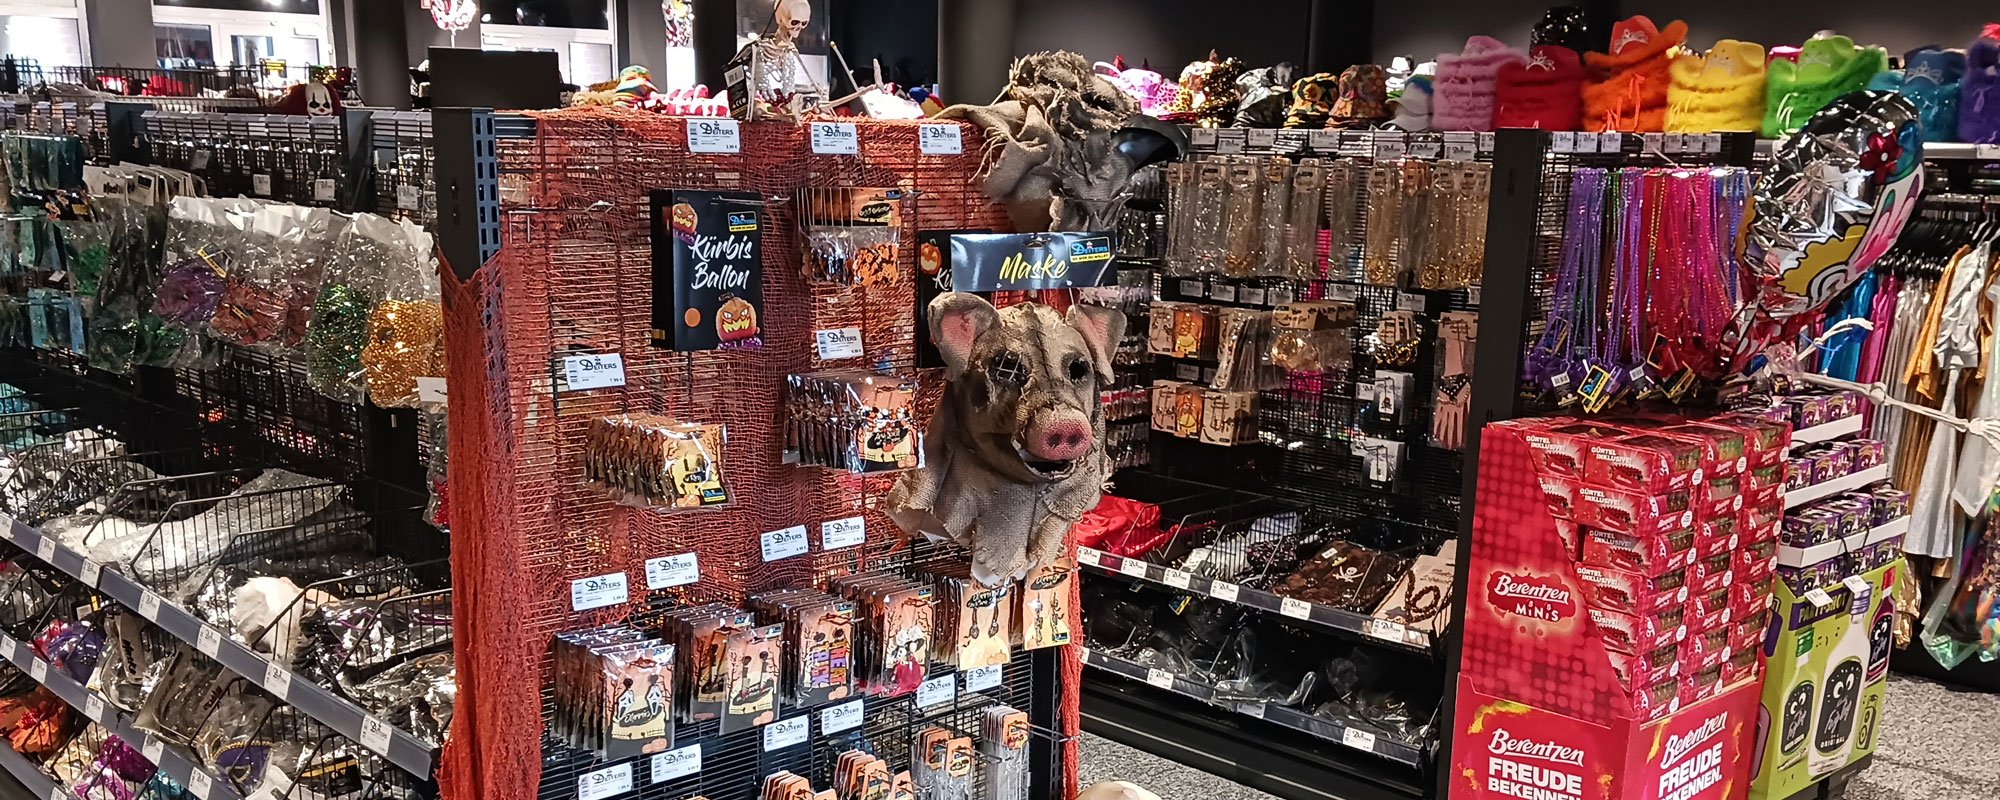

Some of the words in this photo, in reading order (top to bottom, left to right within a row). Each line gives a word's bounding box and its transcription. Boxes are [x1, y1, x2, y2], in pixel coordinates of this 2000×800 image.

[700, 122, 734, 135] DEITERS
[822, 125, 852, 138] DEITERS
[929, 126, 957, 138] DEITERS
[1071, 242, 1108, 255] DEITERS
[688, 234, 753, 282] Kürbis
[999, 251, 1070, 285] Maske
[691, 262, 750, 290] Ballon
[579, 358, 617, 371] DEITERS
[833, 522, 860, 533] DEITERS
[772, 533, 803, 544] DEITERS
[658, 560, 692, 571] DEITERS
[585, 580, 621, 592] DEITERS
[1494, 574, 1570, 604] Berentzen
[832, 708, 859, 718] DEITERS
[776, 722, 804, 733] DEITERS
[1660, 711, 1728, 770] Berentzen
[1488, 728, 1584, 768] Berentzen
[664, 753, 696, 765] DEITERS
[1489, 756, 1582, 796] FREUDE
[1658, 742, 1723, 798] FREUDE
[592, 772, 626, 784] DEITERS
[1661, 766, 1723, 800] KENNEN.
